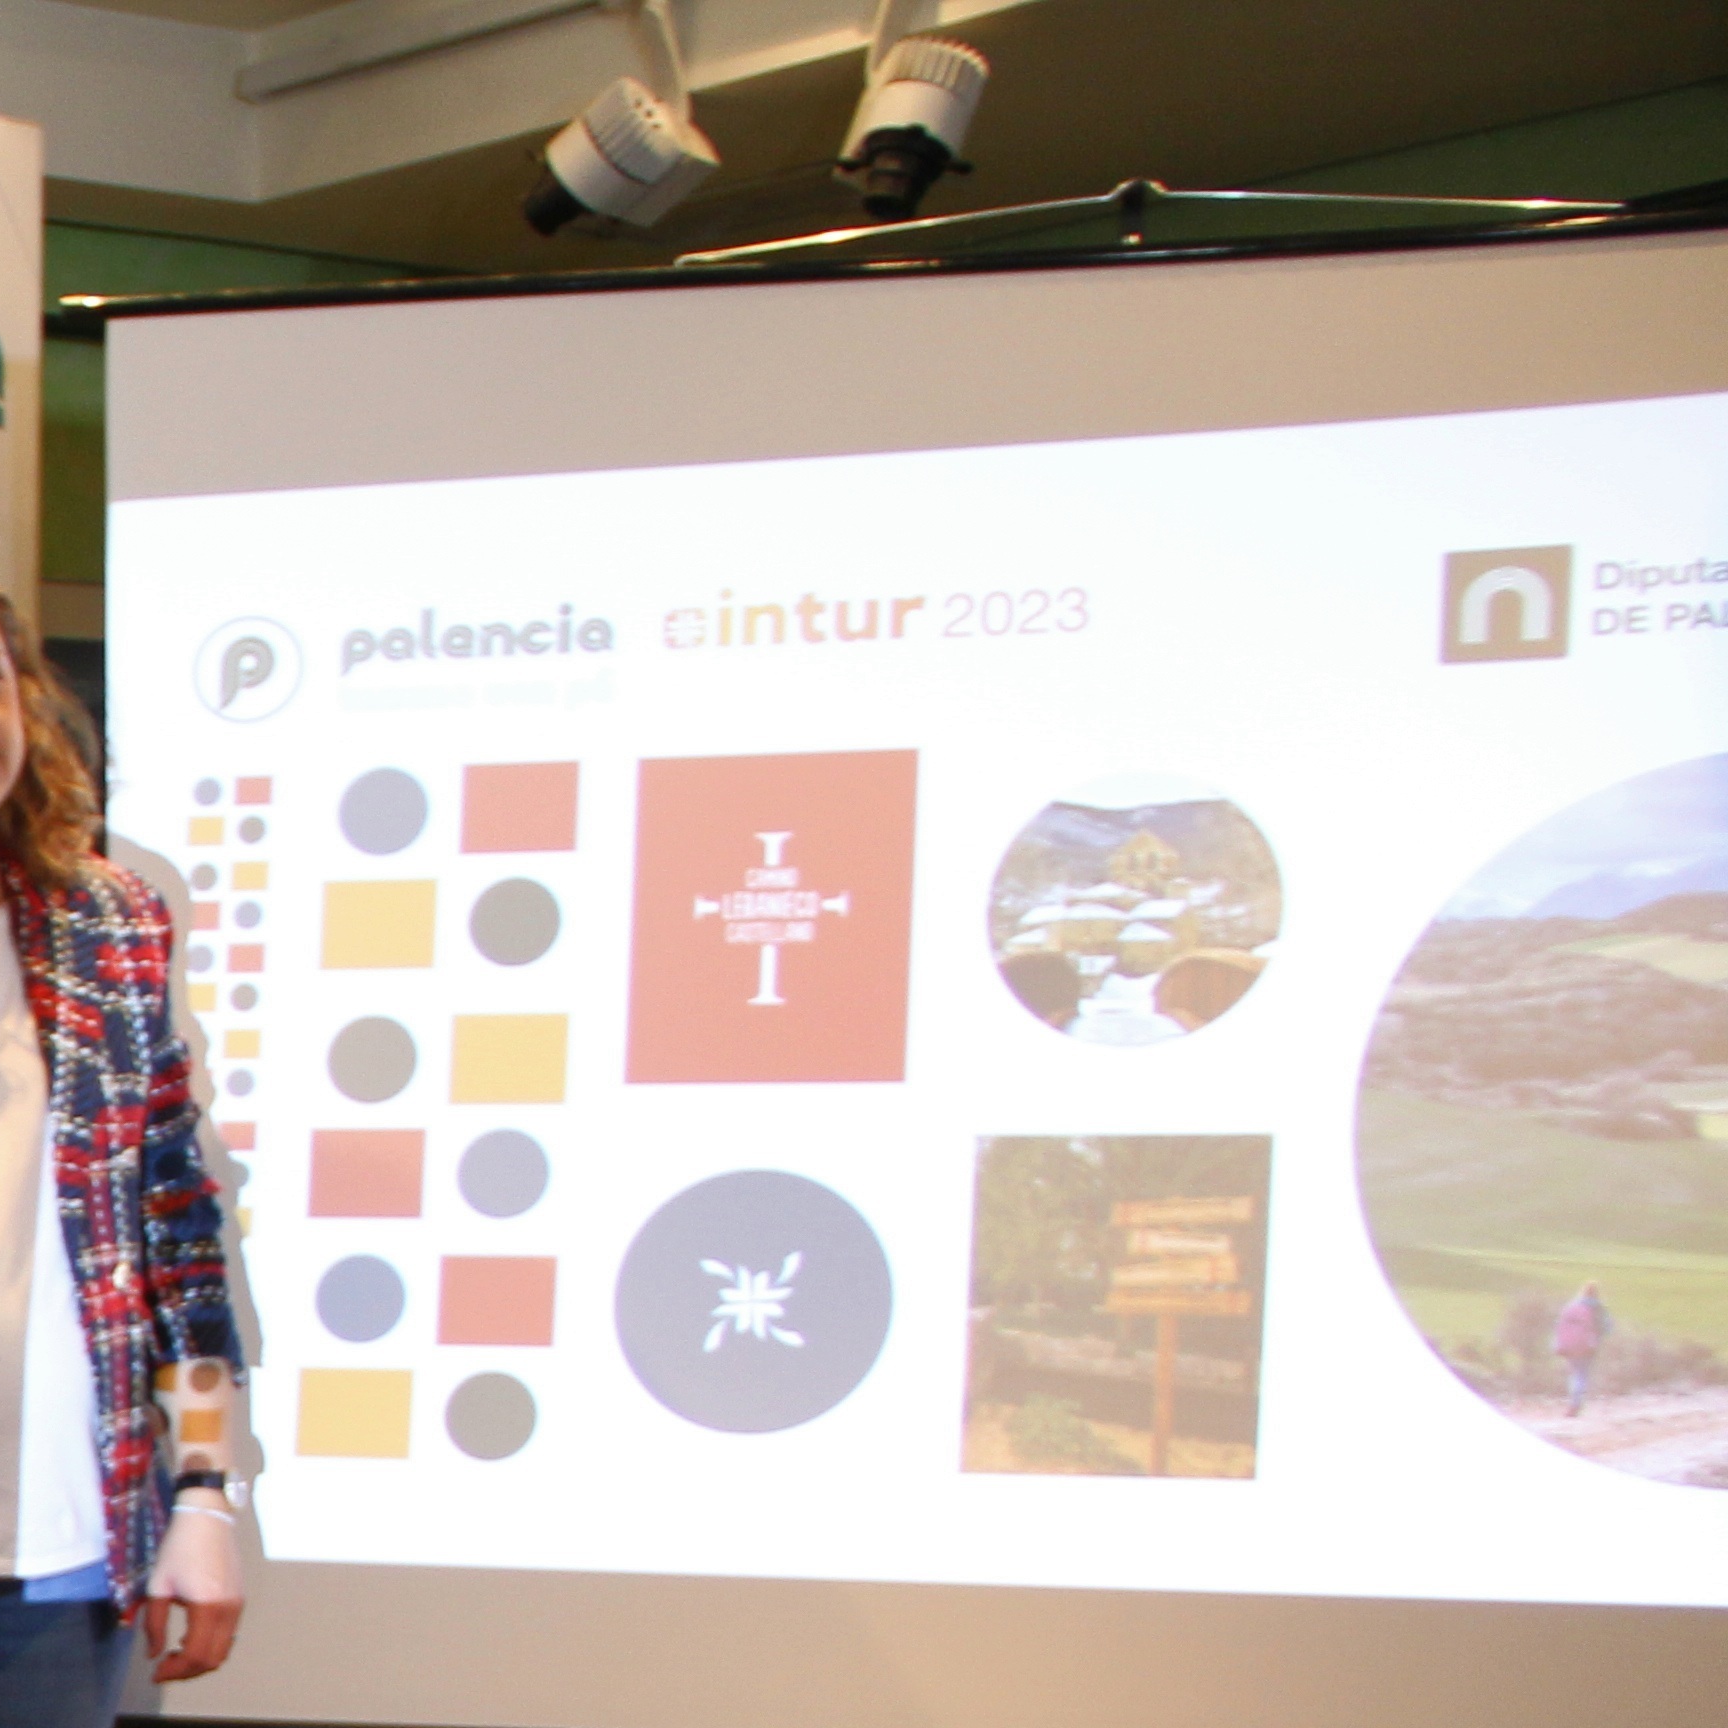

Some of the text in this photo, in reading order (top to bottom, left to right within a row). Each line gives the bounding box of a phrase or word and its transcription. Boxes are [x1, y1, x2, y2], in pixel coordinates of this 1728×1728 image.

[942, 586, 1091, 639] 2023
[1593, 605, 1649, 636] DE
[340, 602, 615, 677] palencia
